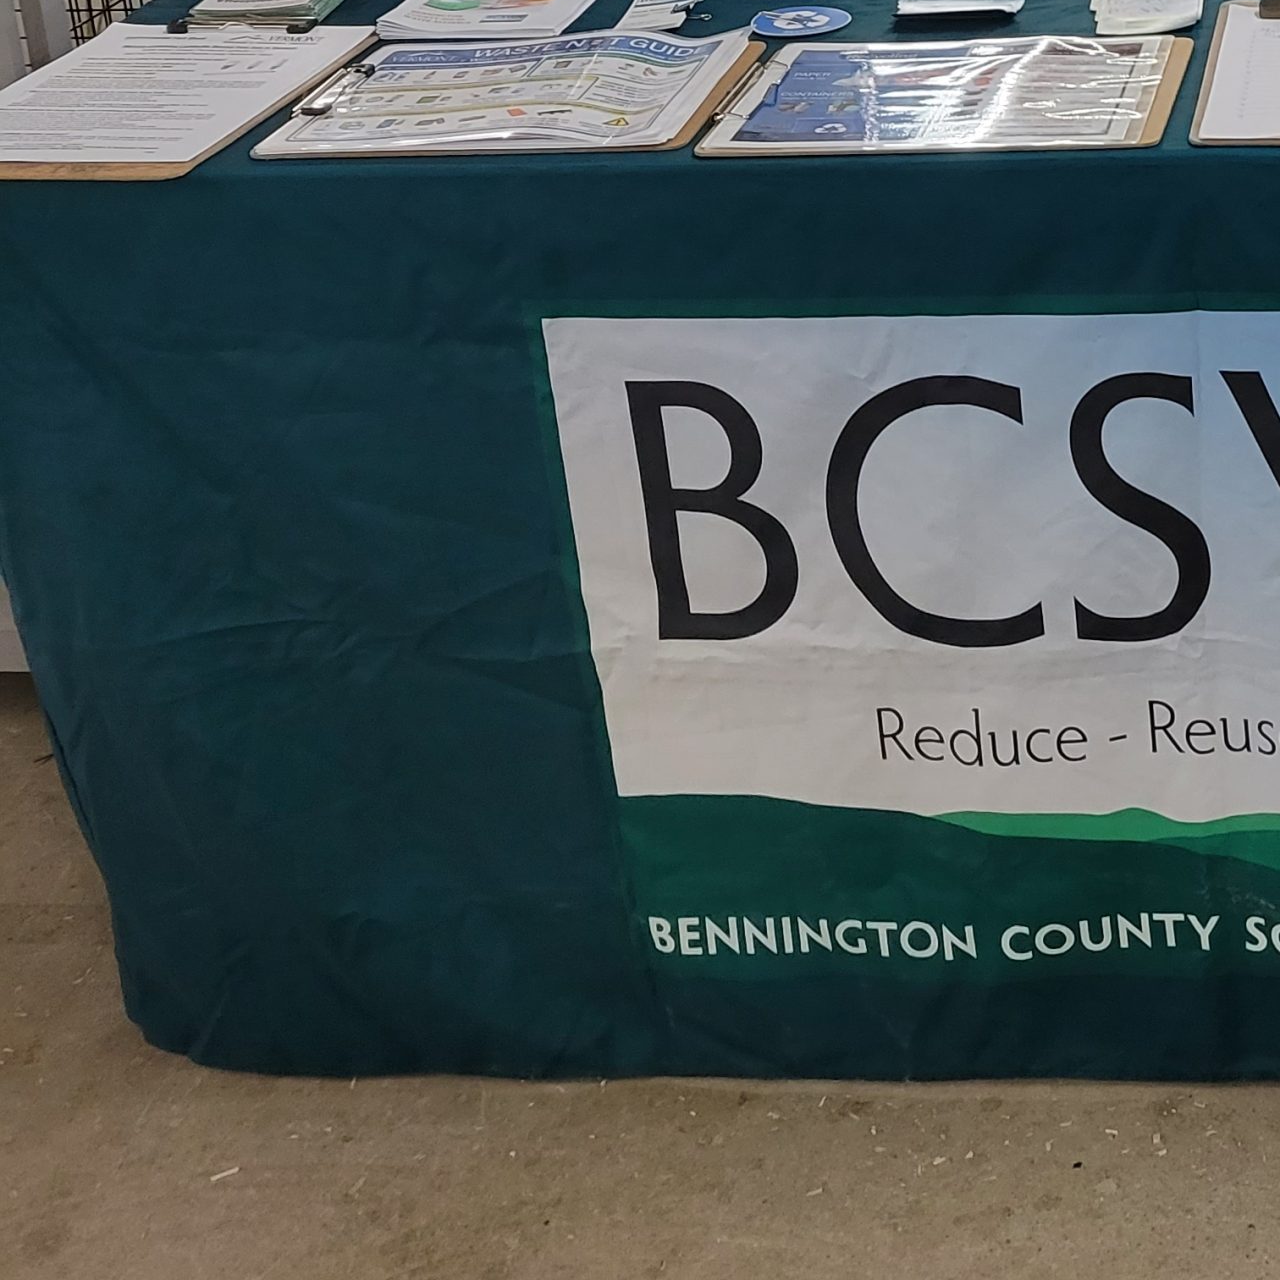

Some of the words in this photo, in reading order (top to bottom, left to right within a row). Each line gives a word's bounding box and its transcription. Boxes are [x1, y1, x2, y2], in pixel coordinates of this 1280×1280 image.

[474, 43, 554, 58] WASTE
[875, 706, 1088, 767] Reduce
[647, 915, 978, 962] BENNINGTON
[1000, 912, 1220, 962] COUNTY
